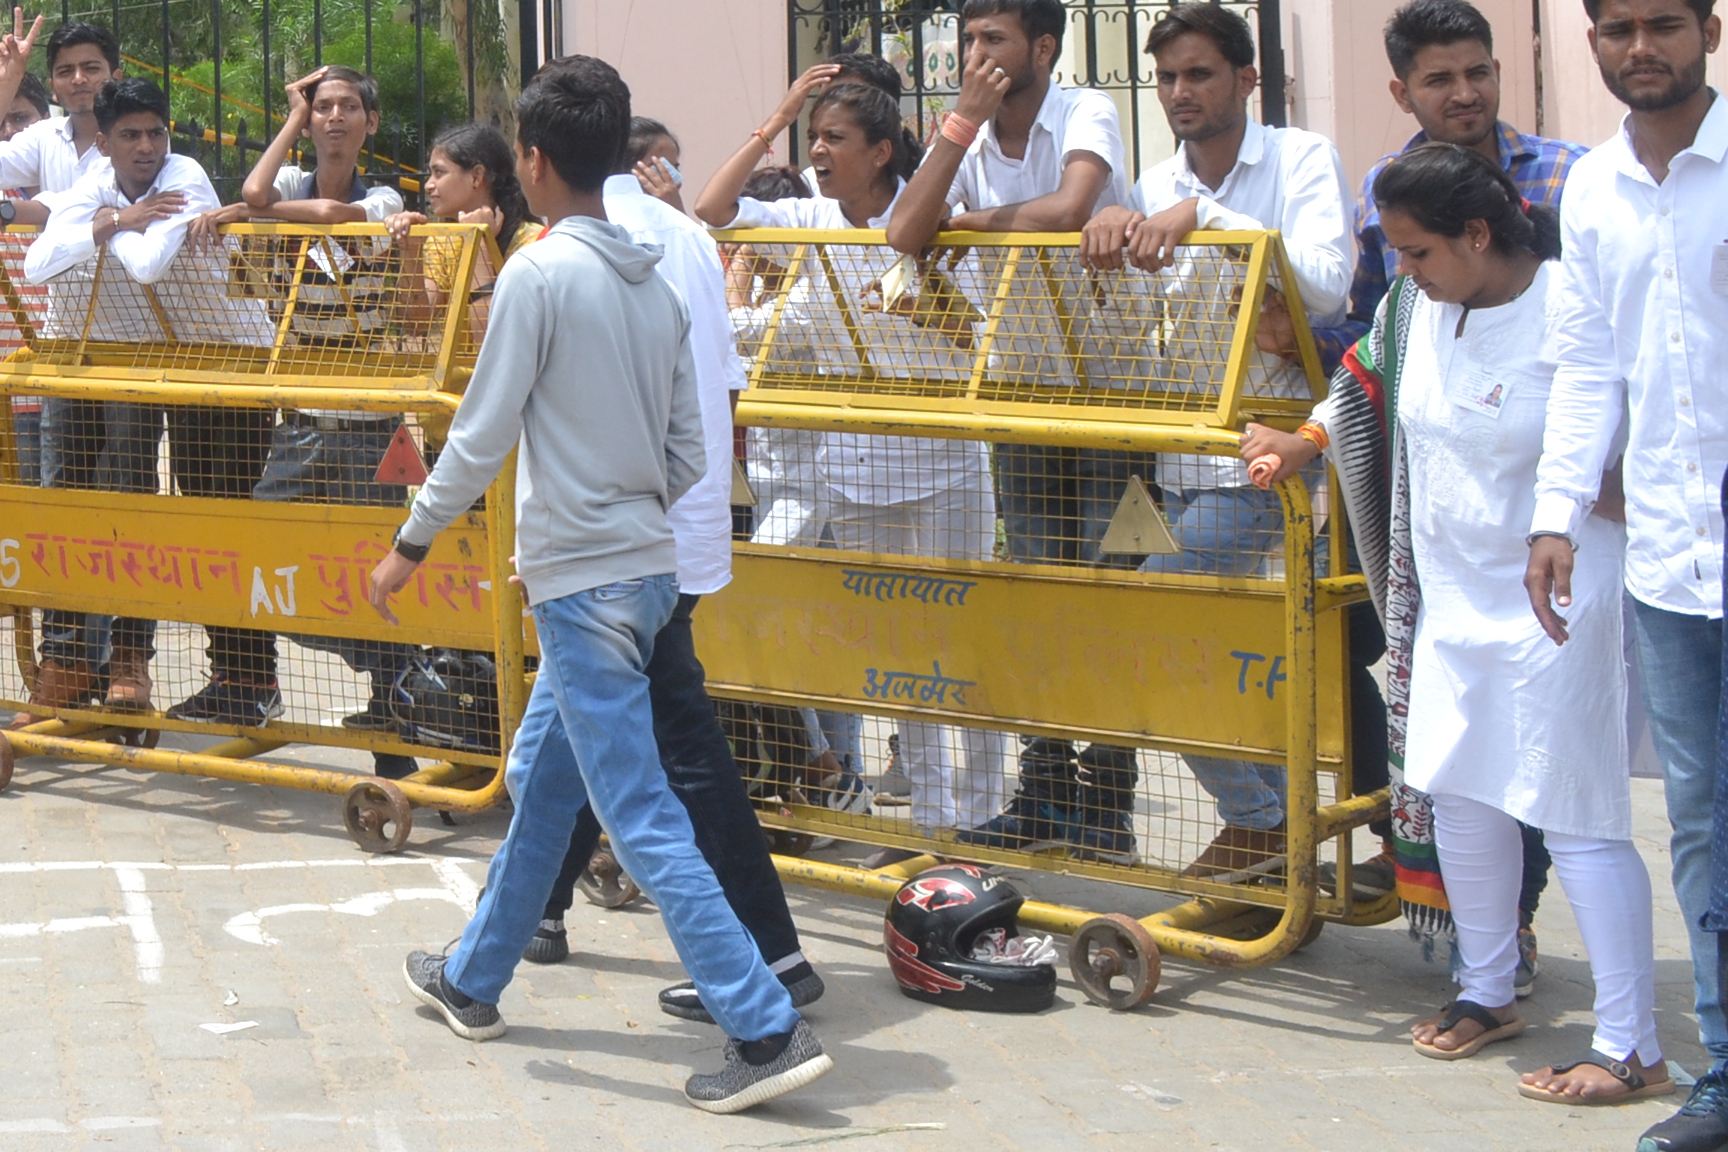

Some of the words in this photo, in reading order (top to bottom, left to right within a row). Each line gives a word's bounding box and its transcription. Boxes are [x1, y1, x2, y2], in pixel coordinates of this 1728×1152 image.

[25, 532, 242, 595] राजस्थान
[309, 539, 484, 616] पुिस
[841, 568, 977, 606] यातायात
[863, 660, 977, 705] अजमेर
